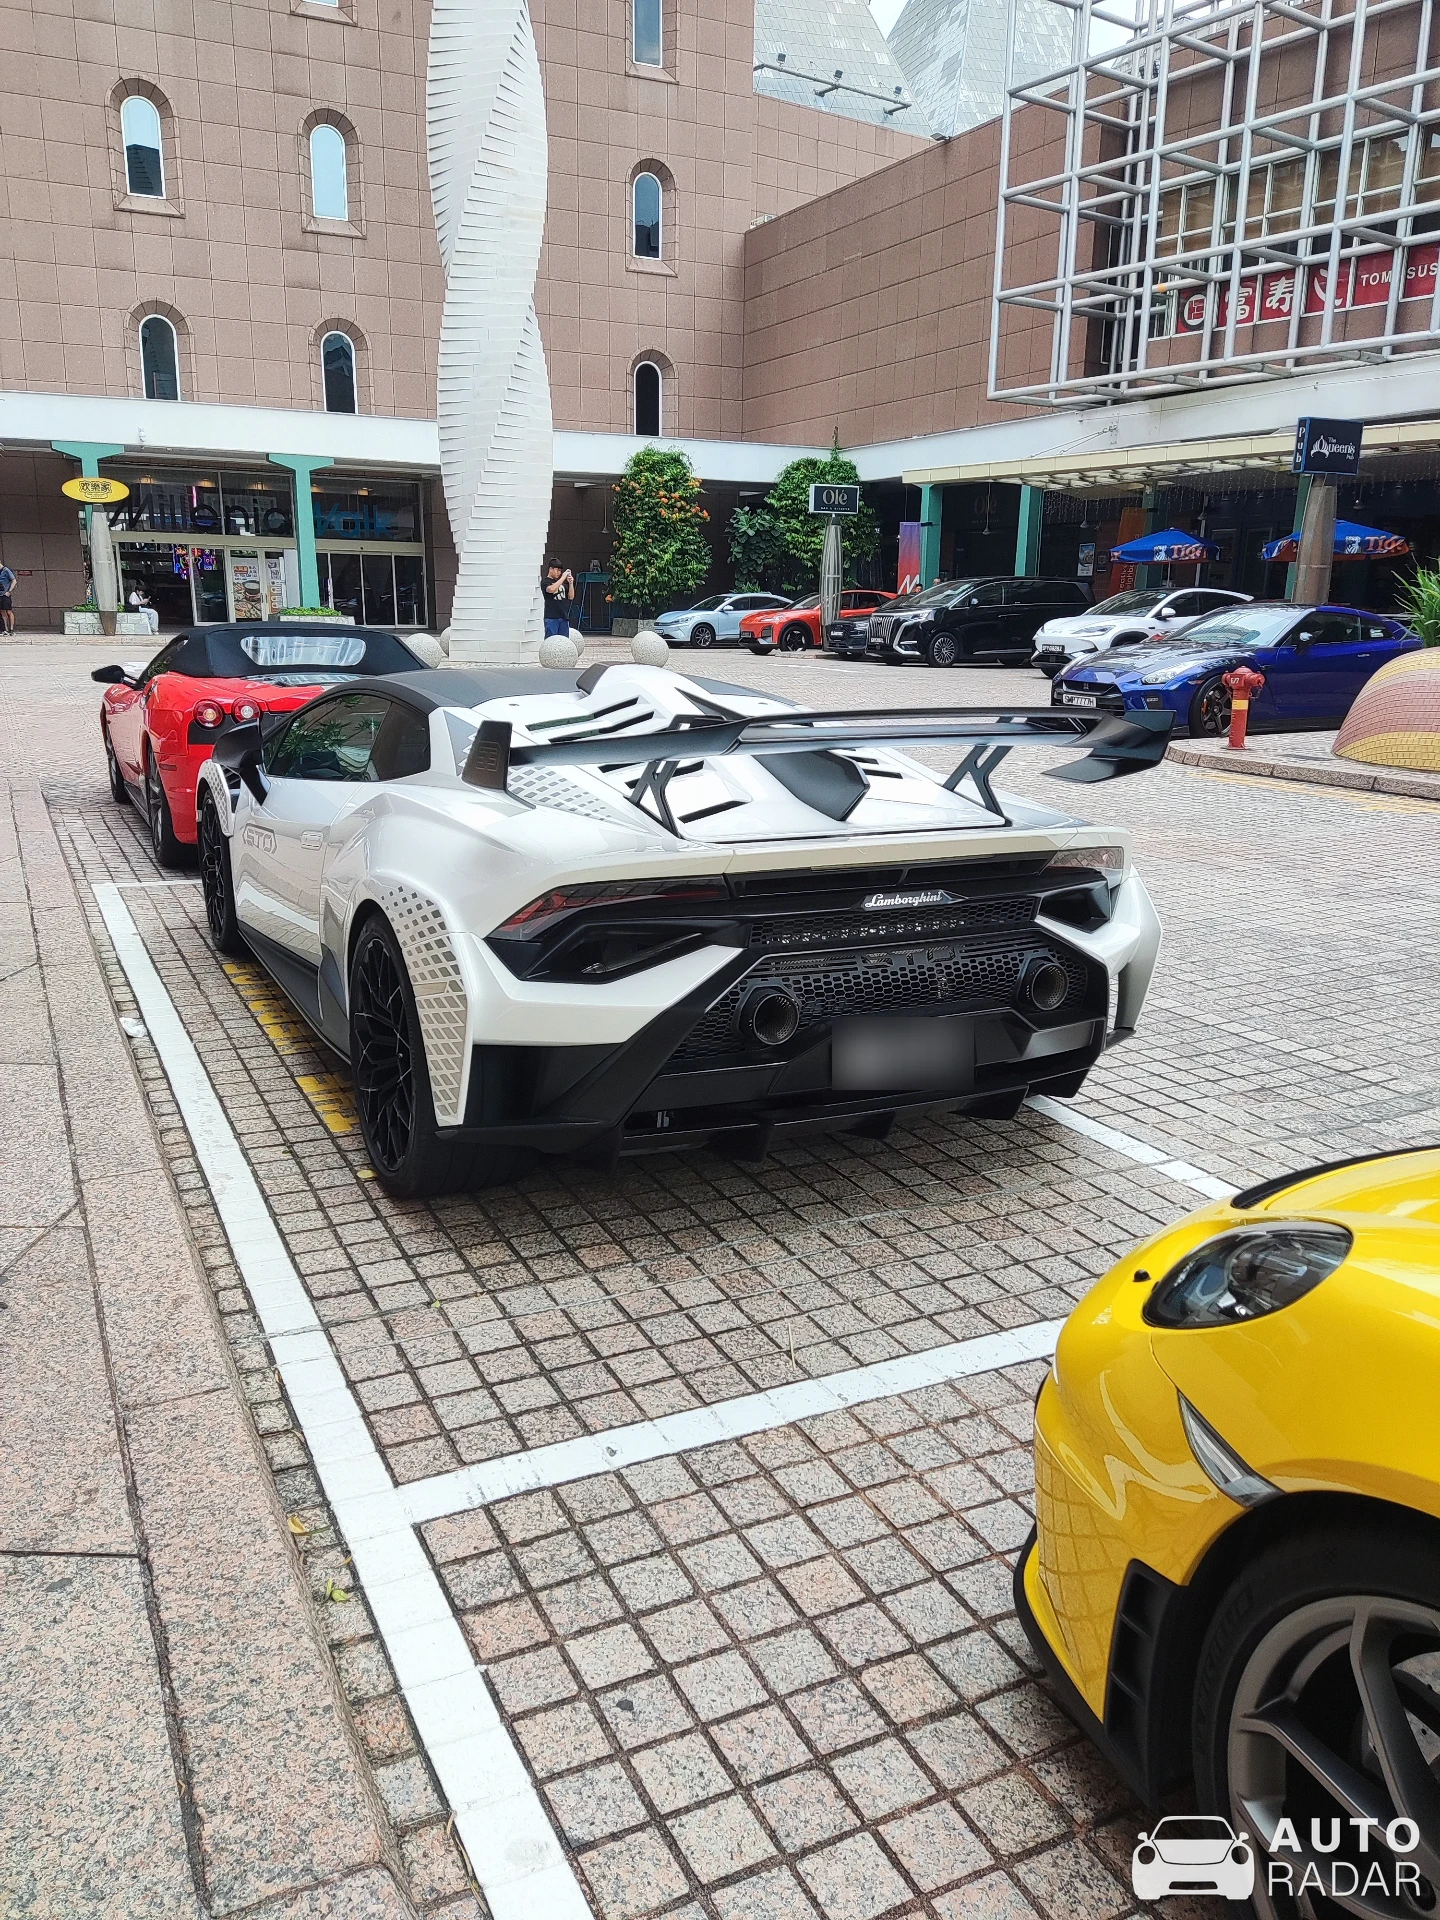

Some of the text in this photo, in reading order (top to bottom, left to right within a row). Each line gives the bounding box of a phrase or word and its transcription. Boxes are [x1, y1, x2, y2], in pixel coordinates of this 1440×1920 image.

[1361, 270, 1396, 287] TOM
[822, 489, 848, 505] Olé
[108, 492, 292, 534] Millenia
[246, 828, 273, 853] STO
[864, 891, 943, 908] Lamborghini
